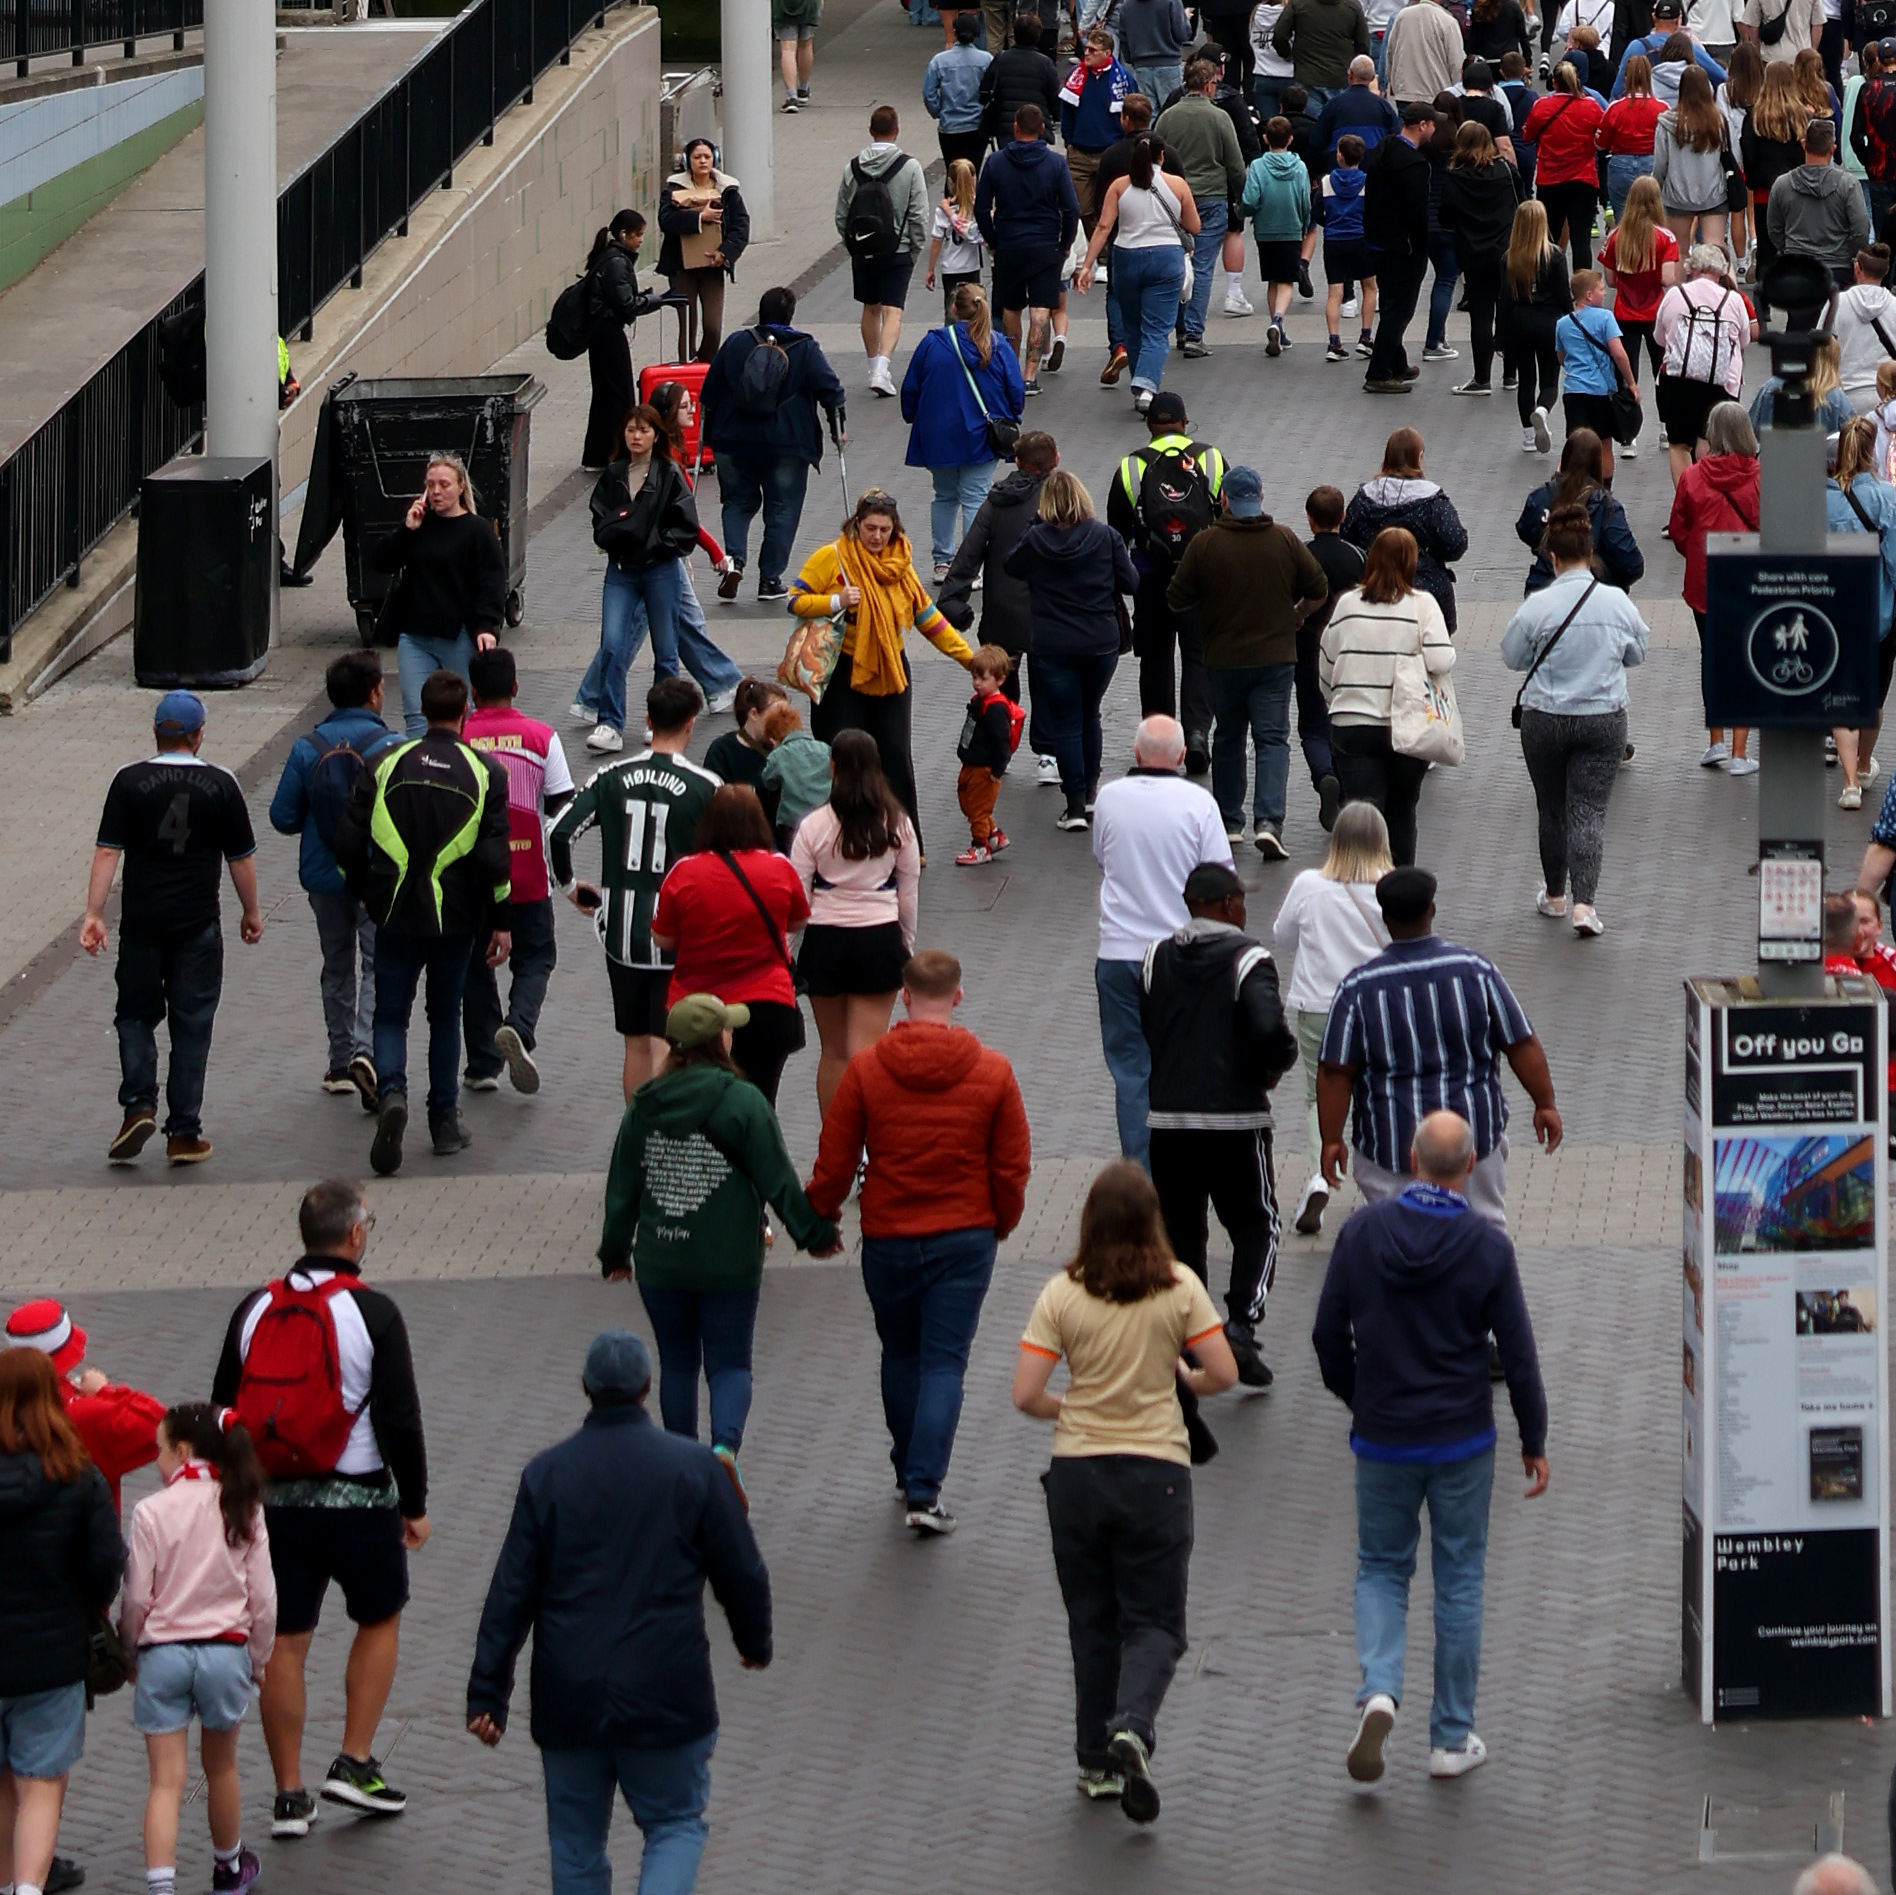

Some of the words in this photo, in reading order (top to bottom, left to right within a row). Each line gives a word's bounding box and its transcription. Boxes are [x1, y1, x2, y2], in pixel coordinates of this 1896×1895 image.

[1758, 571, 1785, 583] Share
[1786, 571, 1807, 582] with
[1808, 573, 1829, 583] care
[1751, 584, 1800, 595] Pedestrian
[1801, 584, 1836, 597] Priority
[139, 768, 184, 794] DAVID
[622, 769, 687, 797] HØJLUND
[158, 793, 192, 853] 4
[625, 799, 670, 874] 11
[1734, 1032, 1777, 1057] Off
[1782, 1035, 1824, 1060] you
[1832, 1031, 1864, 1053] Go
[1717, 1537, 1804, 1554] Wembley
[1717, 1555, 1760, 1571] Park
[1758, 1624, 1802, 1639] Continue
[1803, 1624, 1826, 1637] your
[1826, 1622, 1863, 1636] journey
[1864, 1623, 1877, 1634] on
